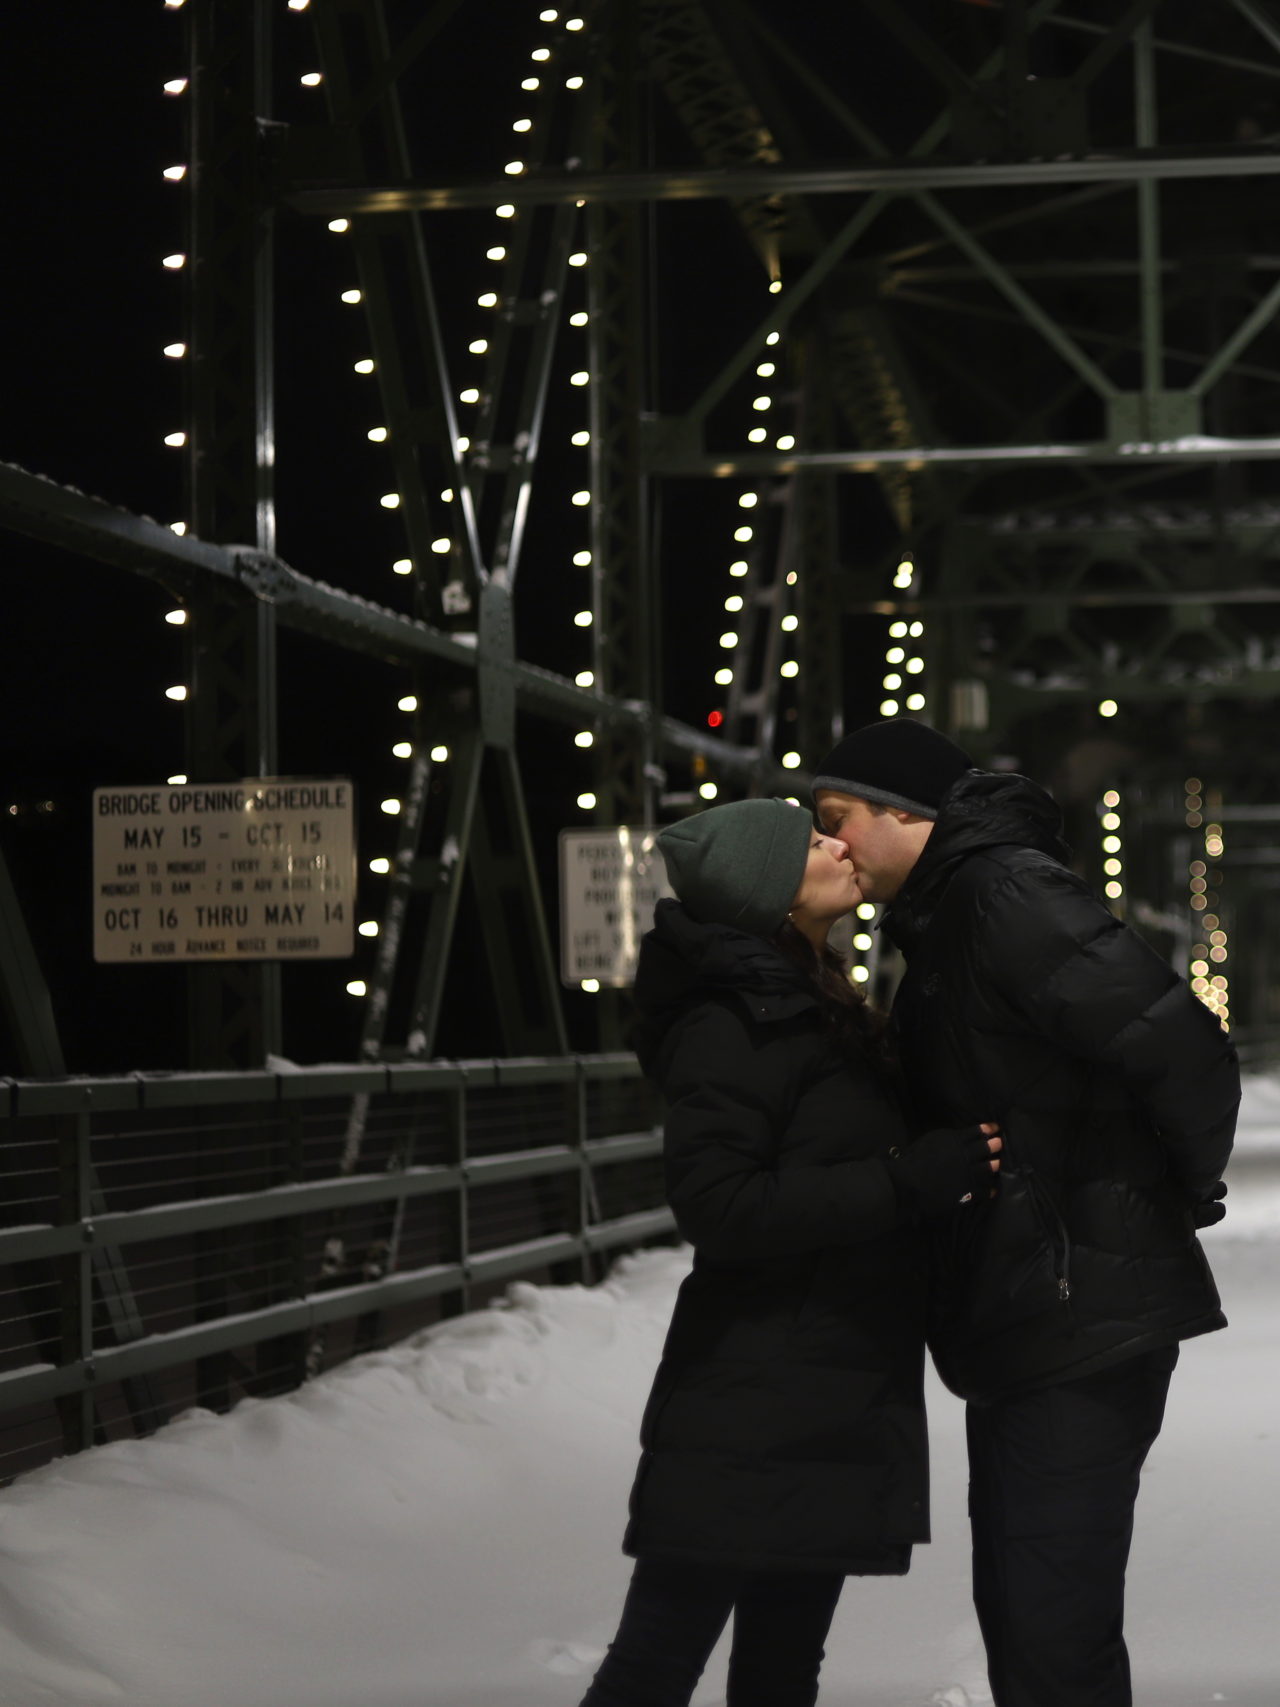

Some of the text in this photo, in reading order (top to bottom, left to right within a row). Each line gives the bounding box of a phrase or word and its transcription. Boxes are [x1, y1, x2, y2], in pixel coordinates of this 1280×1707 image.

[99, 786, 346, 816] BRIDGE OPENING SCHEDULE
[124, 826, 164, 850] MAY
[182, 825, 201, 848] 15
[301, 821, 321, 844] 15
[105, 901, 344, 931] OCT 16 THRU MAY 14
